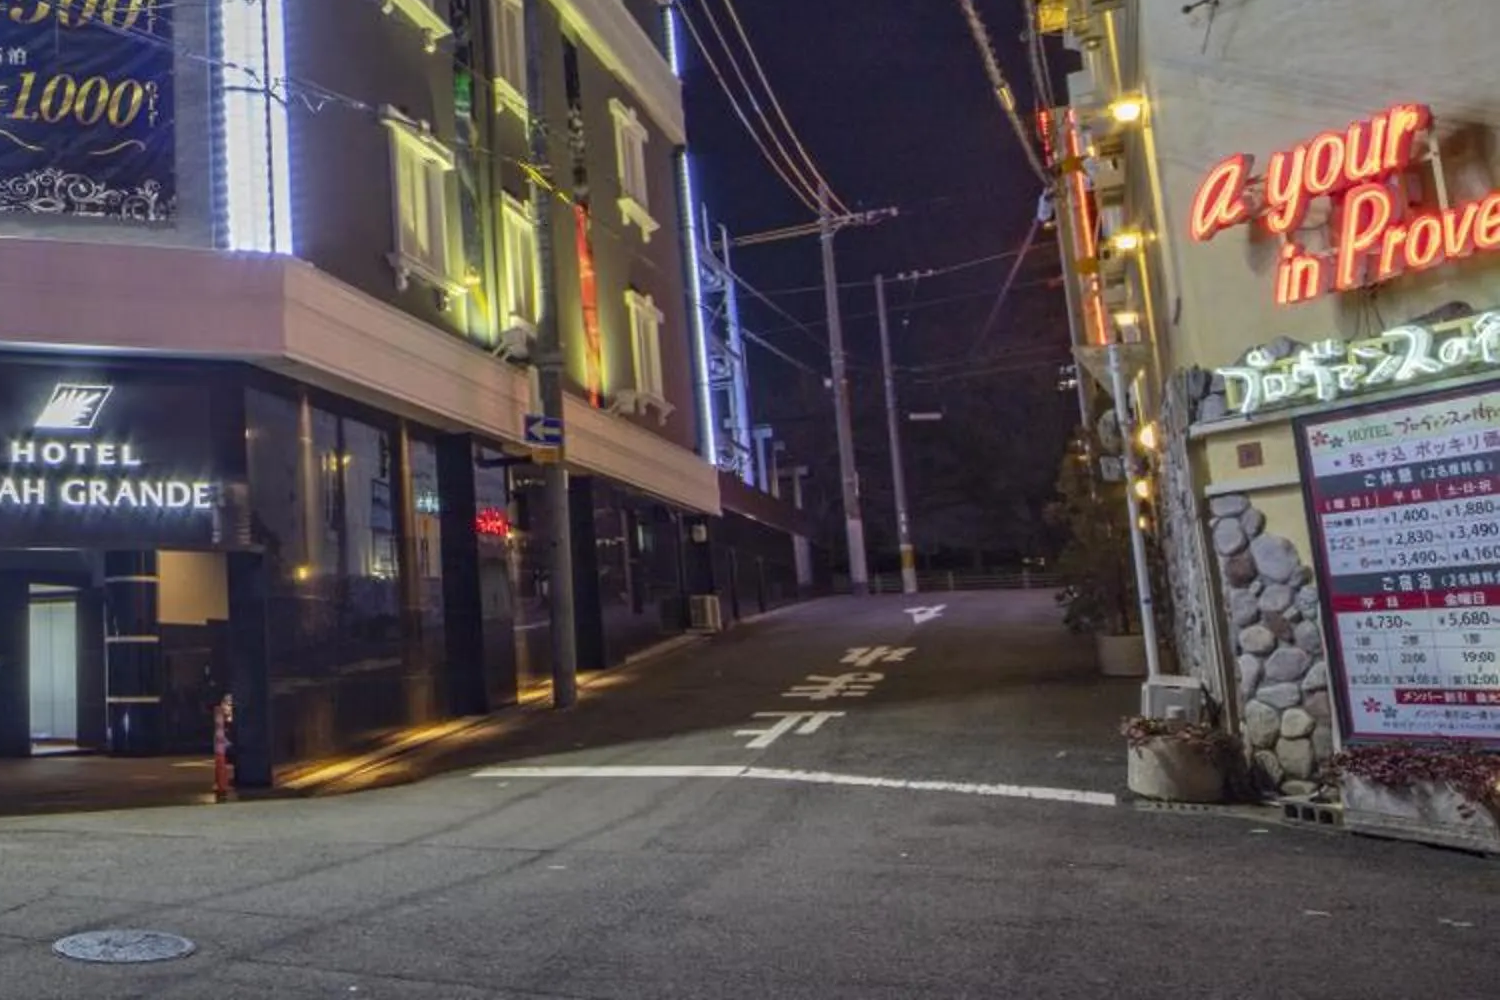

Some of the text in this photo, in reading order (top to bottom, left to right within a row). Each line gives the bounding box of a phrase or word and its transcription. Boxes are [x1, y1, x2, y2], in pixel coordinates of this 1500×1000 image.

[1188, 102, 1435, 243] a your
[1274, 241, 1323, 305] in
[1347, 424, 1394, 443] HOTEL
[10, 441, 142, 466] HOTEL
[60, 478, 213, 509] GRANDE
